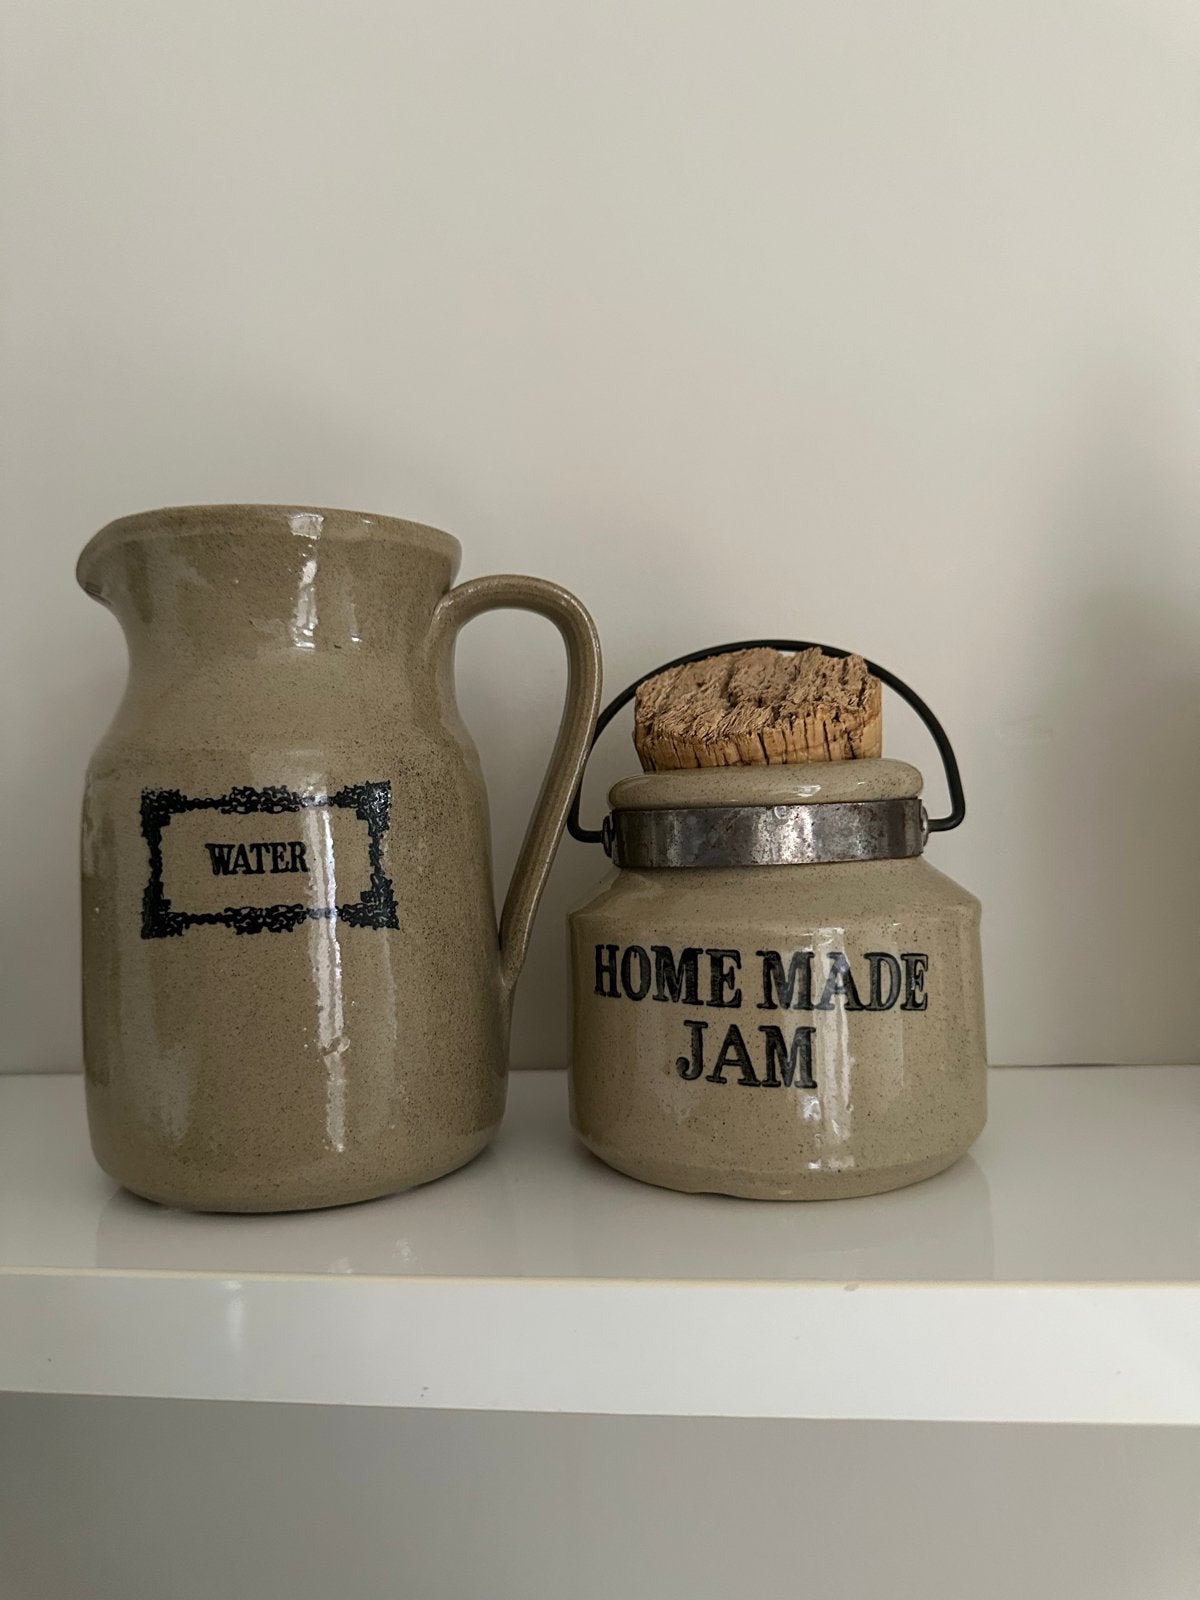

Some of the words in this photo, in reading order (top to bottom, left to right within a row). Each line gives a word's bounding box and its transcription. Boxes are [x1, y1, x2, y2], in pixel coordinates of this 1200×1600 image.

[205, 841, 310, 875] WATER
[594, 944, 742, 1008] HOME
[756, 950, 928, 1011] MADE
[676, 1020, 817, 1089] JAM
